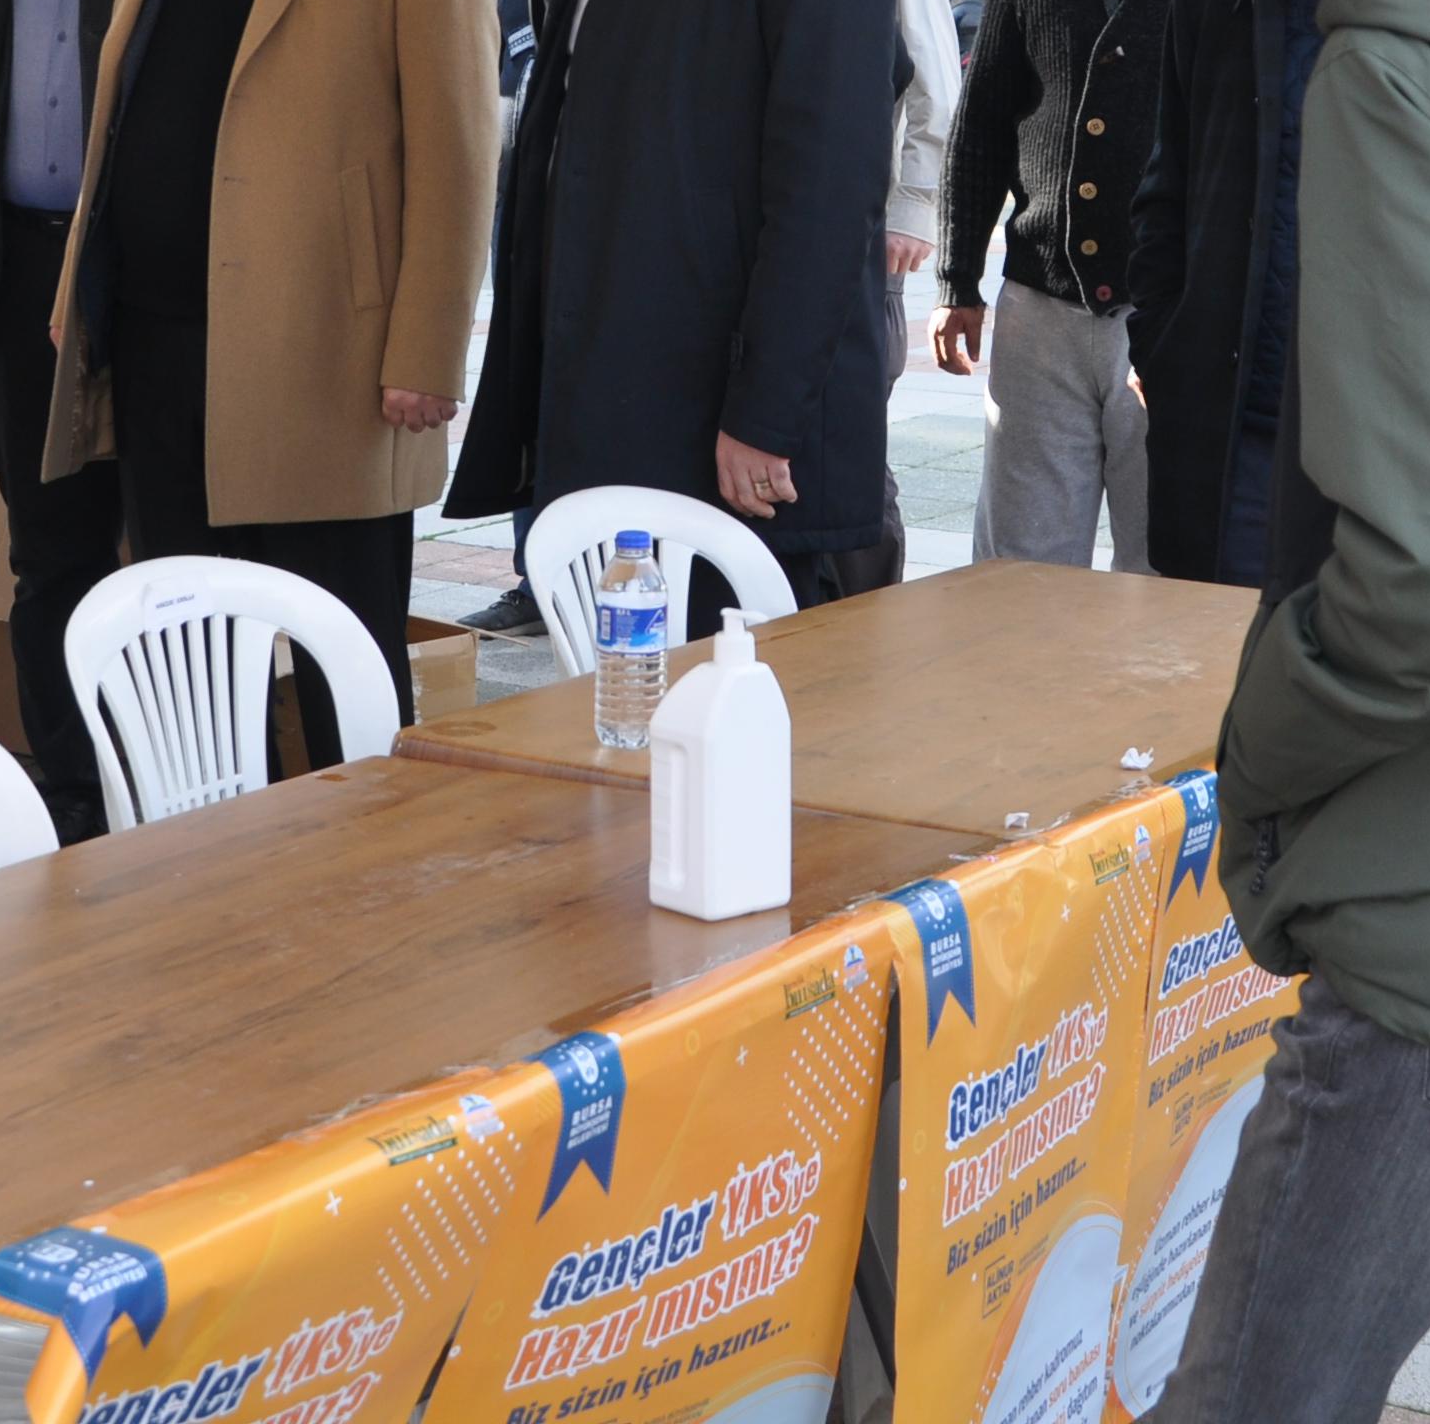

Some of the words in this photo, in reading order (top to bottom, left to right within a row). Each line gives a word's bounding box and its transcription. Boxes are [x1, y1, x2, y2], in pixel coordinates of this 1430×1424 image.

[1187, 820, 1213, 840] BURSA
[929, 932, 962, 956] BURSA
[1158, 912, 1244, 1001] Gençle
[1148, 985, 1209, 1066] Hazır
[944, 1035, 1050, 1151] Gençler
[1167, 1055, 1194, 1093] sizin
[1195, 1039, 1220, 1076] için
[572, 1095, 613, 1126] BURSA
[942, 1129, 1010, 1228] Hazır
[1008, 1062, 1107, 1181] mısınız?
[947, 1236, 970, 1276] Biz
[973, 1212, 1007, 1257] sizin
[1009, 1189, 1033, 1235] için
[1035, 1157, 1087, 1210] hazırız...
[1181, 1195, 1211, 1230] rehber
[530, 1192, 718, 1318] Gençler
[505, 1295, 647, 1390] Hazır
[644, 1214, 819, 1346] mısınız?
[1129, 1314, 1139, 1329] ve
[75, 1347, 272, 1424] ençler
[555, 1377, 627, 1420] sizin
[632, 1358, 683, 1400] için
[687, 1318, 791, 1375] hazırız...
[1044, 1328, 1084, 1384] kadromuz
